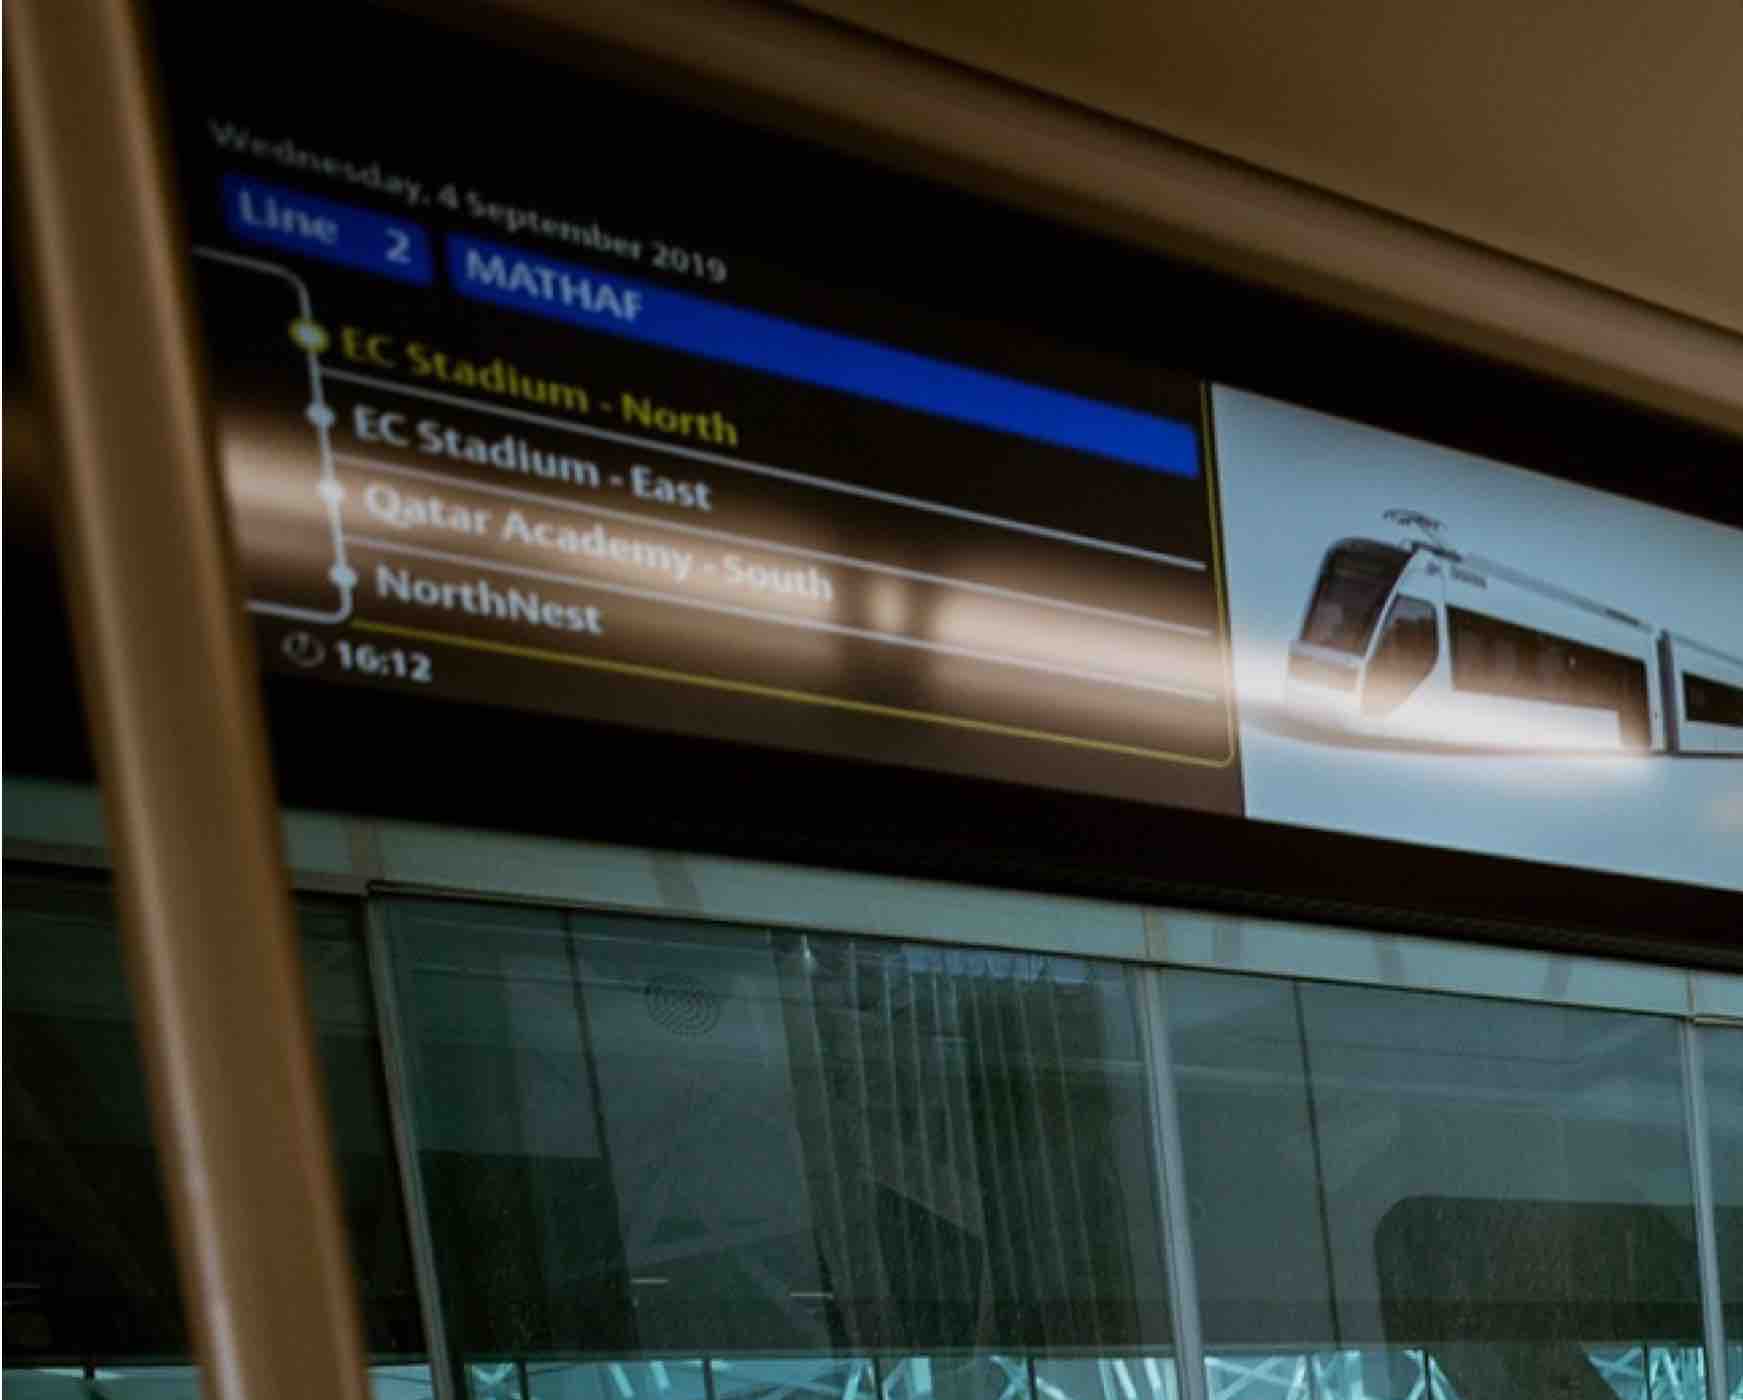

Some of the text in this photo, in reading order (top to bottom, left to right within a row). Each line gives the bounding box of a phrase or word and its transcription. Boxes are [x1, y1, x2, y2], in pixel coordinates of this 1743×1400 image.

[206, 116, 728, 285] Wednesday, 4 September 2019
[236, 188, 412, 265] Line 2
[464, 248, 644, 322] MATHAF
[339, 326, 396, 366] EC
[408, 337, 588, 414] Stadium
[621, 392, 740, 448] North
[352, 405, 407, 447] EC
[418, 418, 600, 489] Stadium
[632, 464, 713, 512] East
[363, 484, 490, 536] Qatar
[501, 510, 695, 583] Academy
[723, 556, 834, 603] South
[374, 563, 606, 636] NorthNest
[336, 640, 432, 684] 16:12
